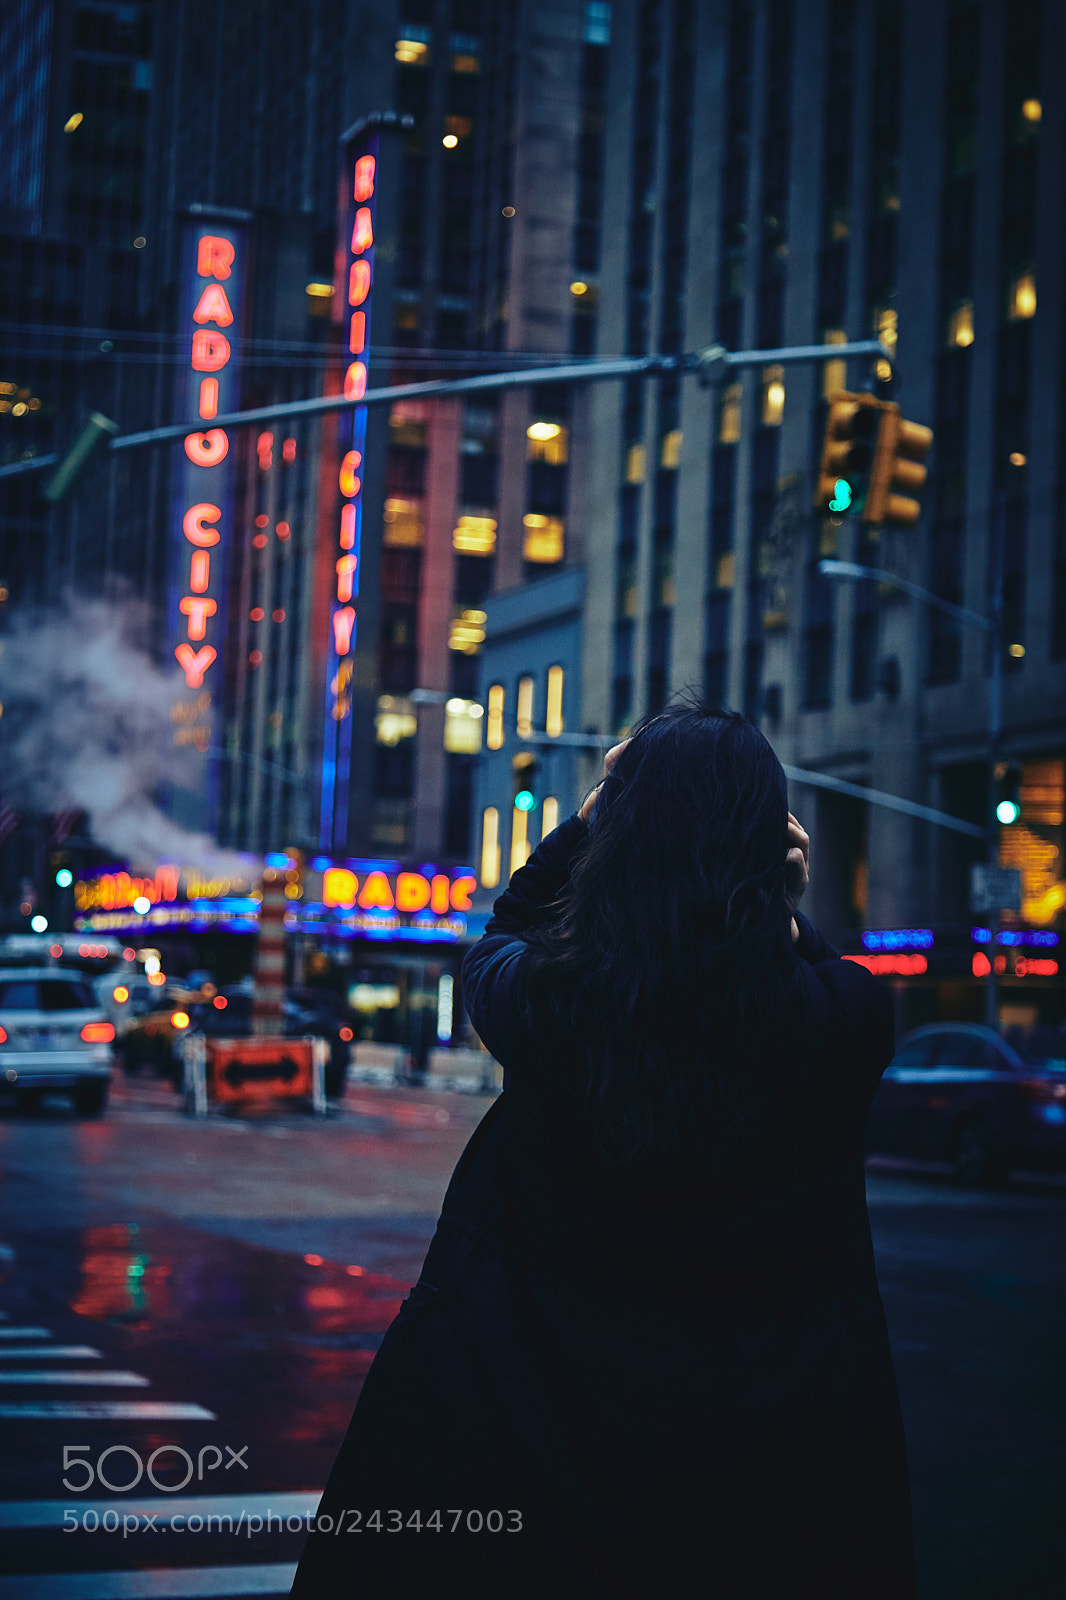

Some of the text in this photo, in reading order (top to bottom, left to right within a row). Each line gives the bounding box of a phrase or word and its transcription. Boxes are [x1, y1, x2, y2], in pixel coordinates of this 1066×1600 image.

[184, 235, 236, 468] RADIO
[343, 154, 376, 402] RADIO
[174, 502, 222, 689] CITY
[333, 449, 362, 656] CITY
